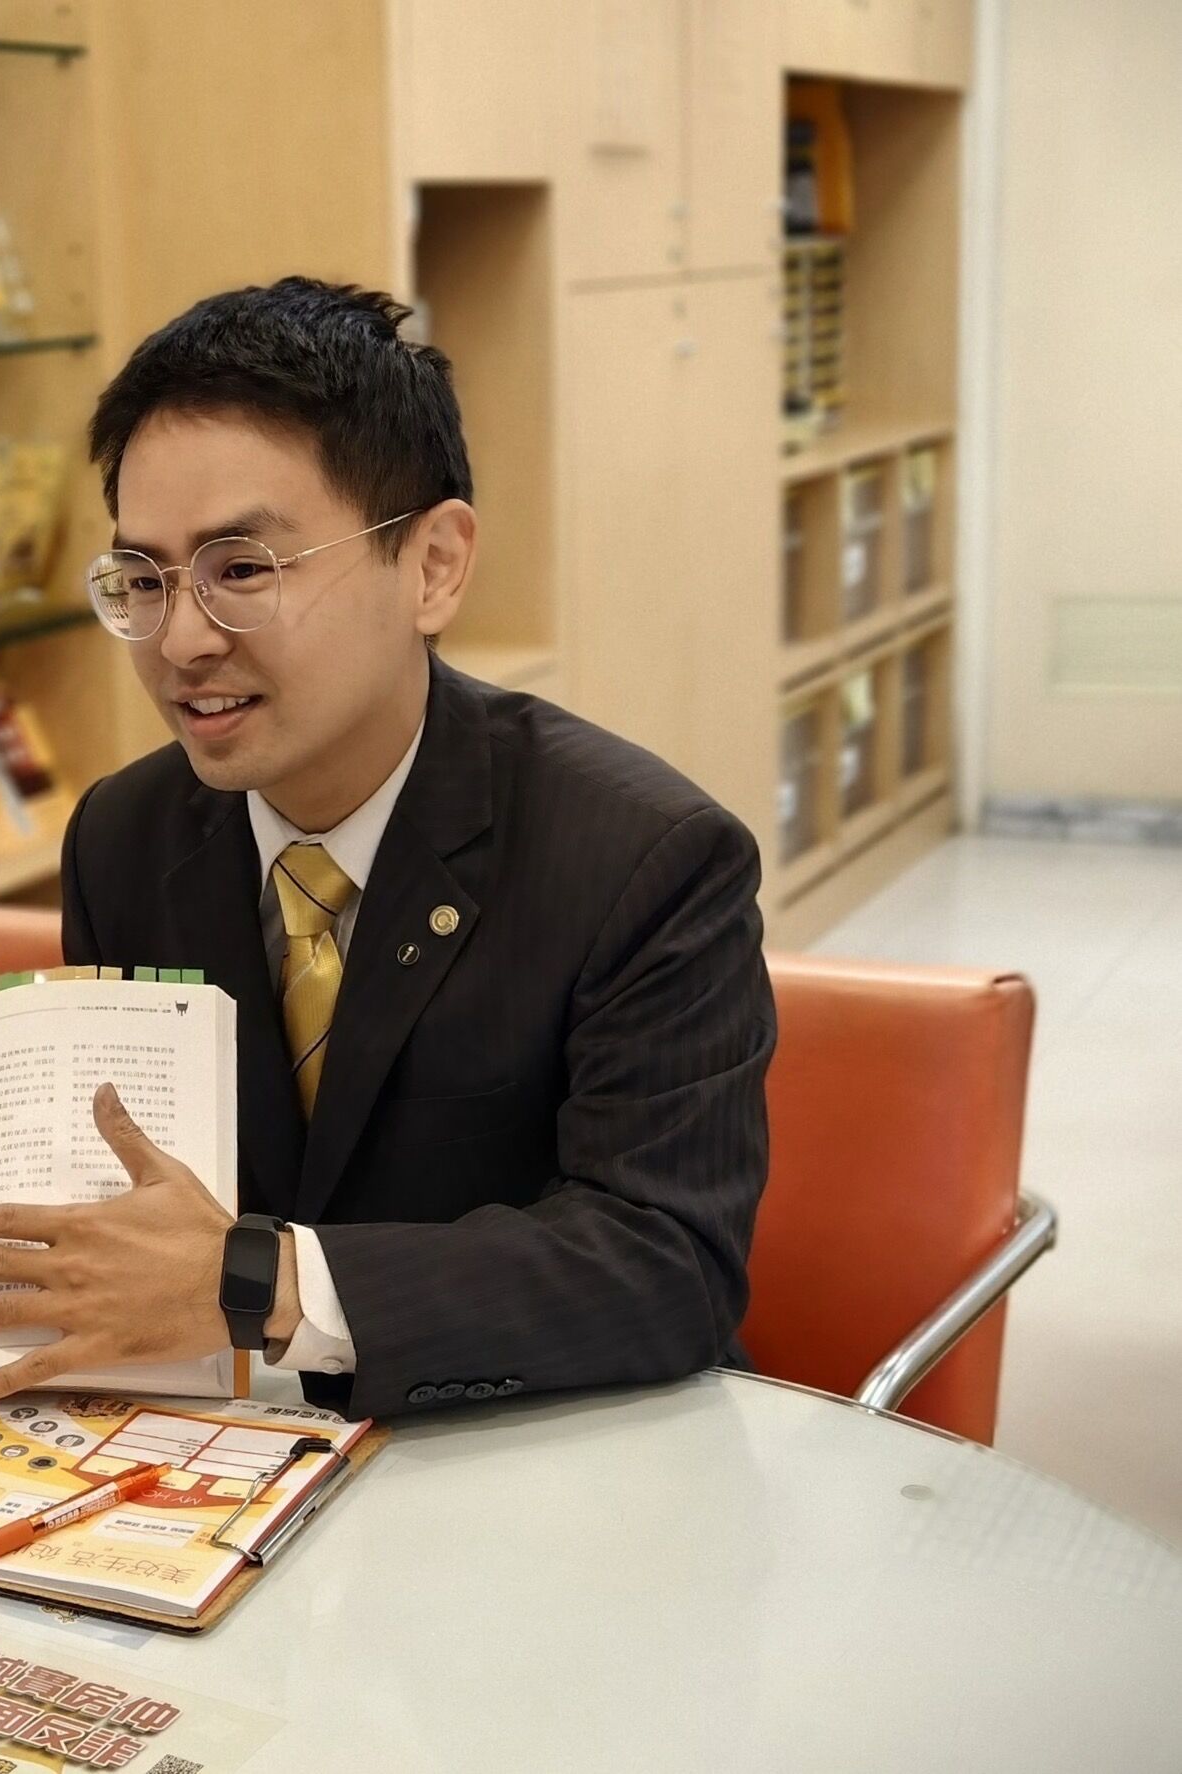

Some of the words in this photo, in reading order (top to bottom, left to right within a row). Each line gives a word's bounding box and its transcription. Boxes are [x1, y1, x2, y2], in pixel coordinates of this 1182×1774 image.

[171, 1496, 202, 1506] MY
[66, 1550, 195, 1585] 美好生活
